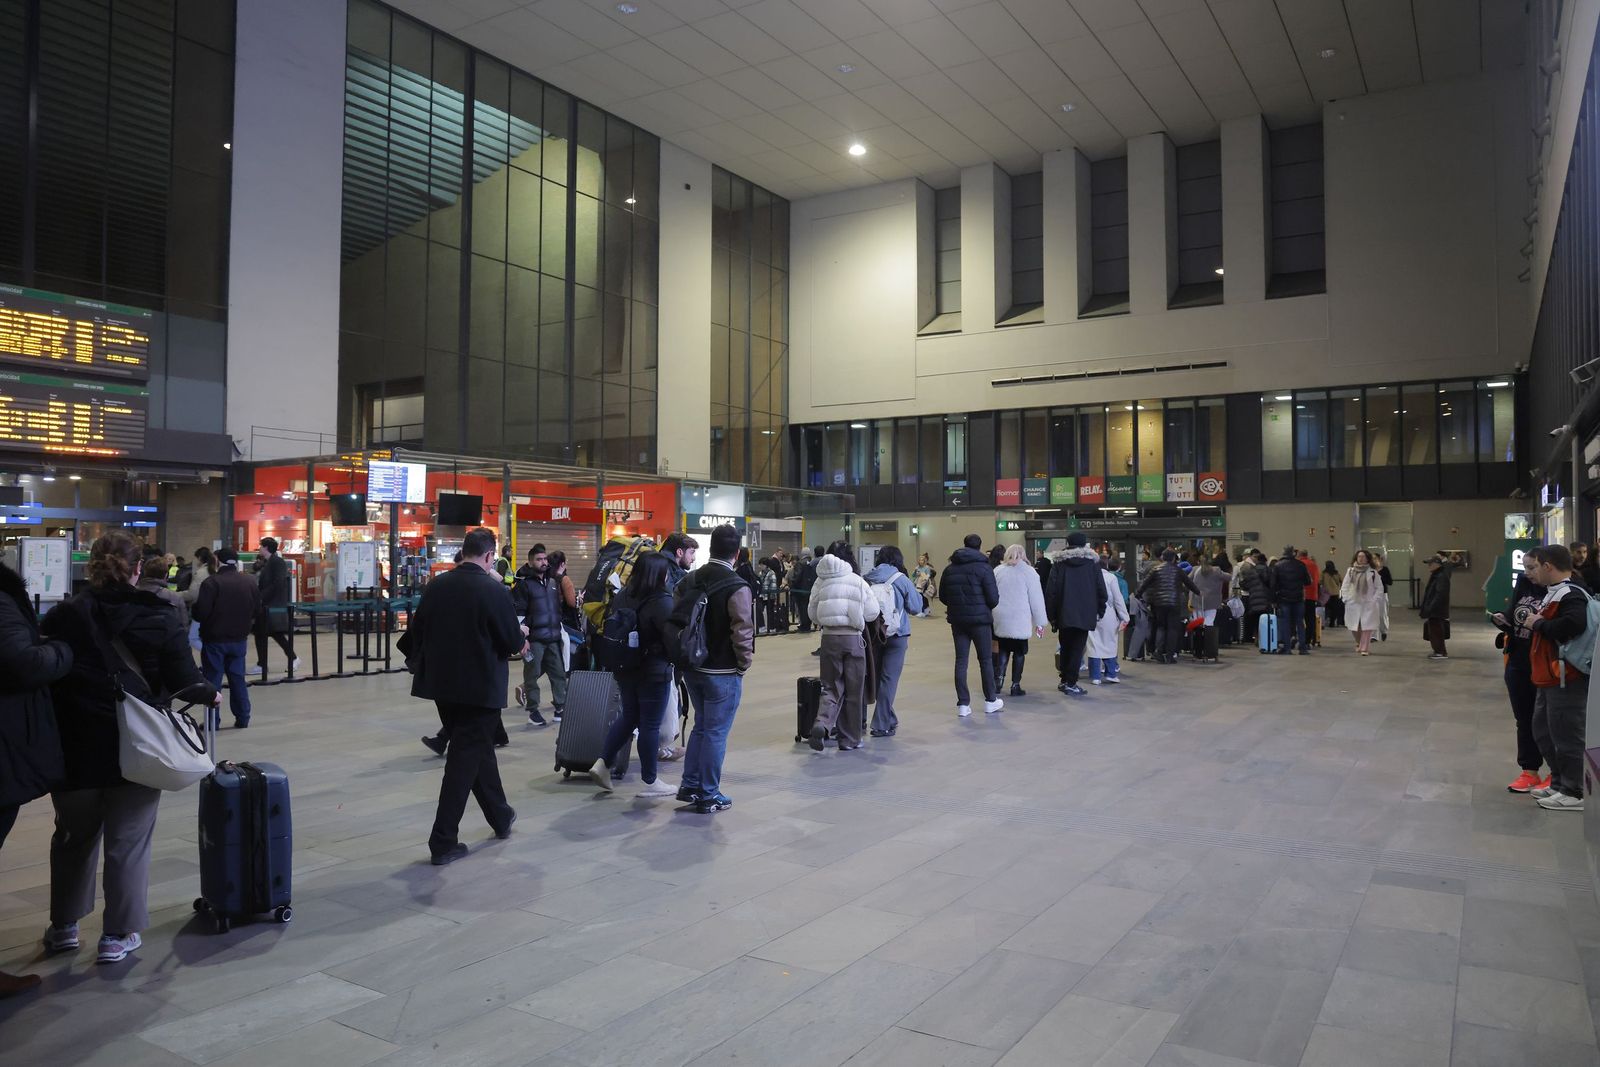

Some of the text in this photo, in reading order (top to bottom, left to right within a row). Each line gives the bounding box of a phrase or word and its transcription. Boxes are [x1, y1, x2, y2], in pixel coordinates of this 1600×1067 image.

[1080, 485, 1101, 496] RELAY
[551, 506, 570, 519] RELAY
[699, 516, 736, 528] CHANGE
[1201, 519, 1212, 527] P1
